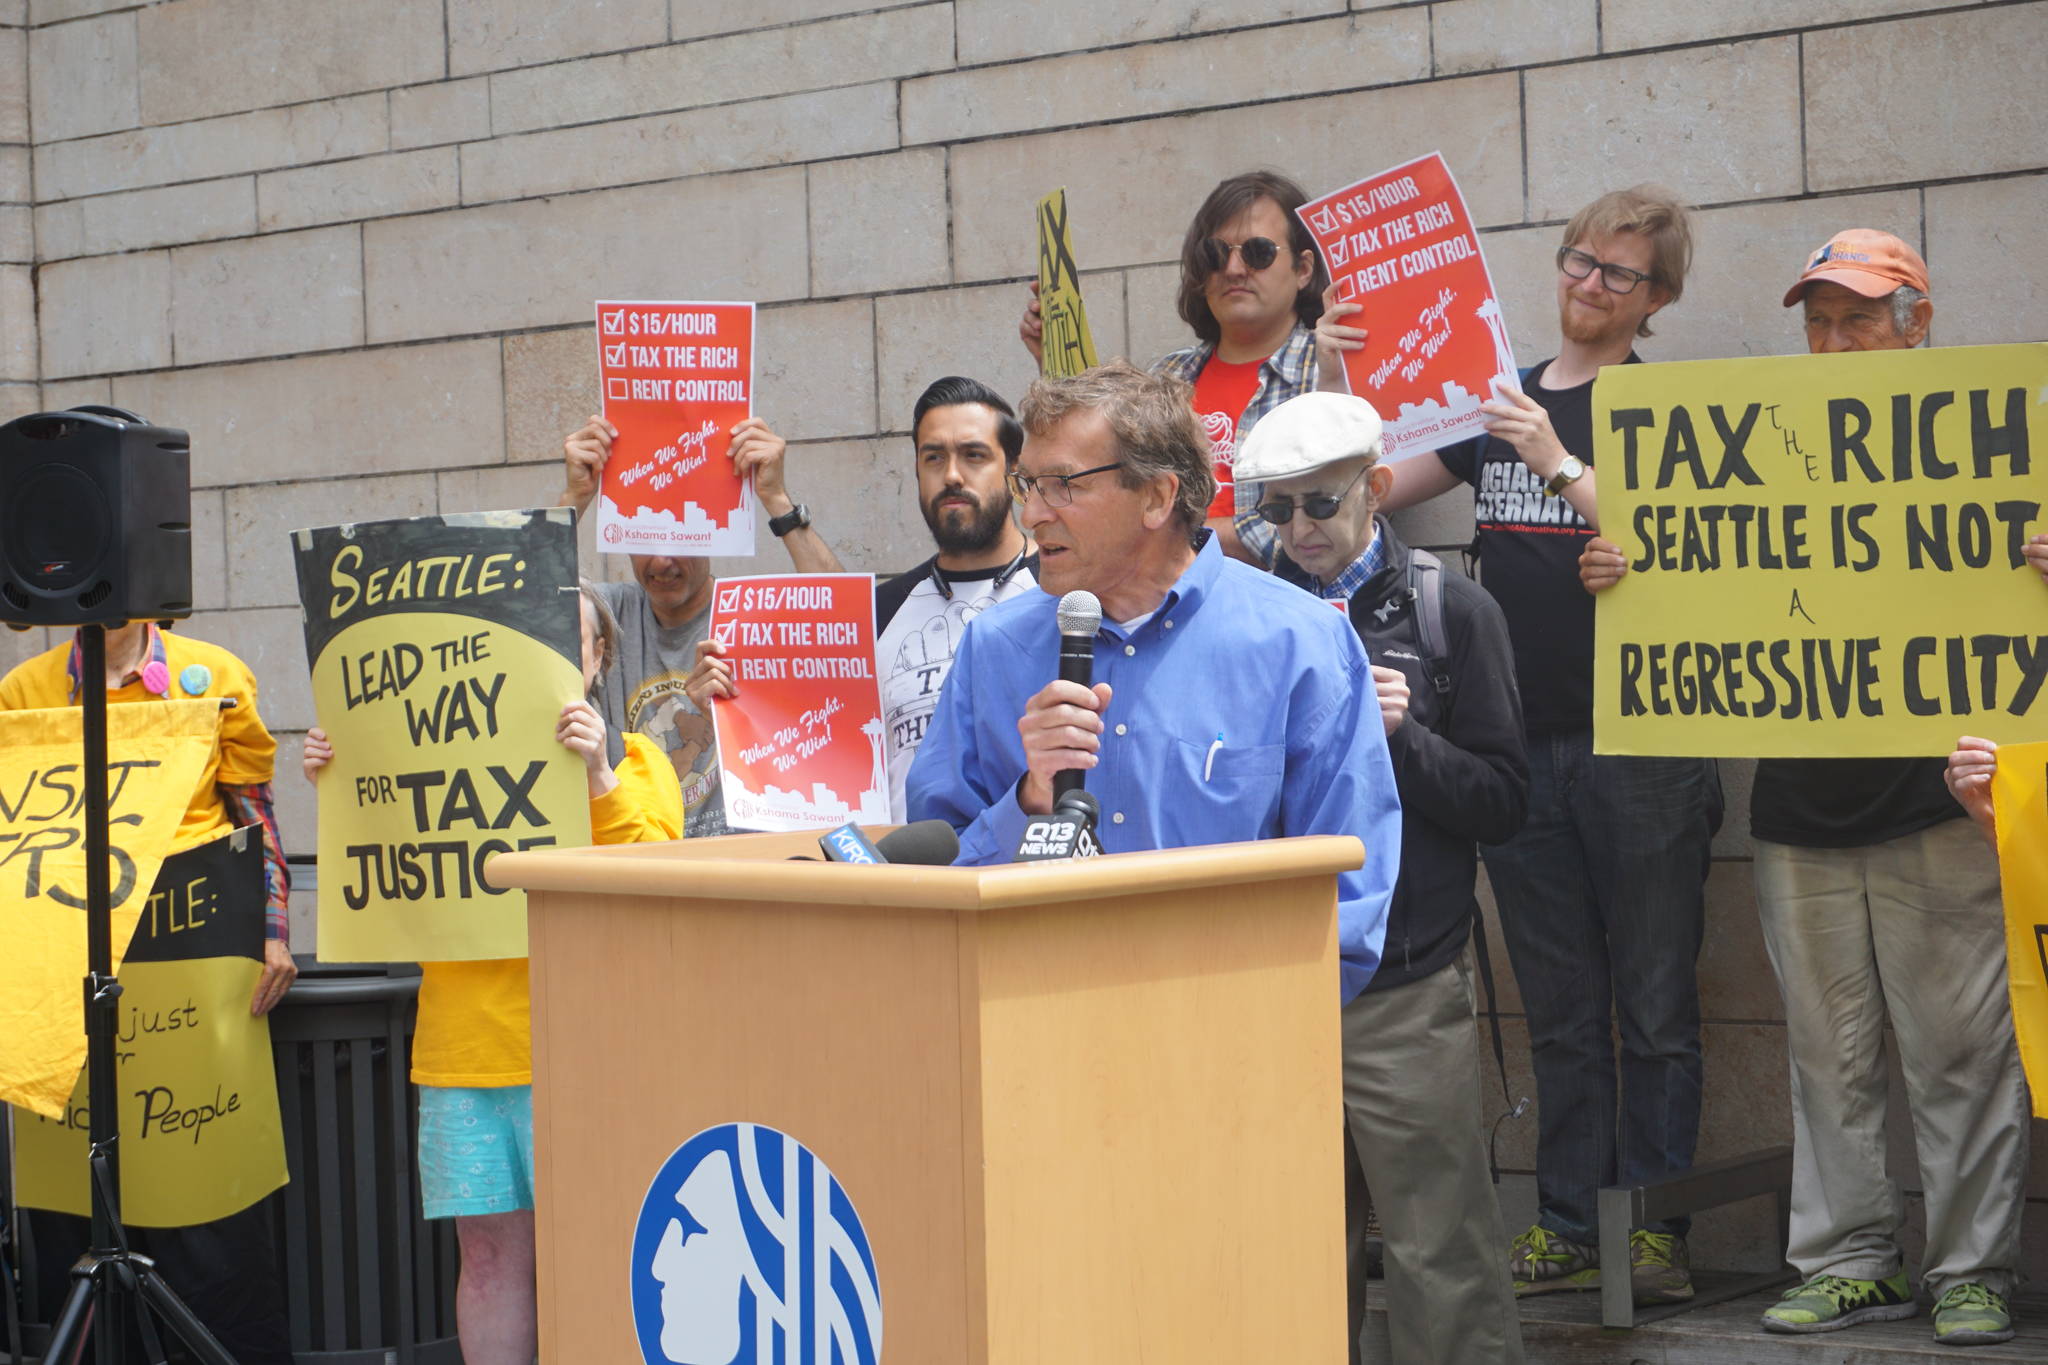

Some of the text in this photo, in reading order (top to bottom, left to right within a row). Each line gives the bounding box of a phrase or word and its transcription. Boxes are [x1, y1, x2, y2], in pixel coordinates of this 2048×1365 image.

[1336, 176, 1420, 224] $15/HOUR
[1349, 201, 1454, 258] TAX THE RICH
[1357, 235, 1476, 293] RENT CONTROL
[629, 312, 716, 335] $15/HOUR
[629, 346, 738, 368] TAX THE RICH
[1368, 352, 1402, 390] When
[1399, 329, 1422, 351] We
[1402, 317, 1453, 383] We Win!
[632, 379, 746, 402] RENT CONTROL
[1396, 423, 1440, 443] Kshama
[1610, 403, 1766, 490] TAX
[1828, 387, 2032, 483] RICH
[619, 459, 654, 487] When
[655, 445, 677, 463] We
[649, 447, 707, 491] We Win!
[1481, 462, 1549, 492] OCIAL
[625, 529, 711, 542] Kshama Sawant
[1632, 501, 2041, 573] SEATTLE IS NOT
[742, 586, 833, 611] $15/HOUR
[1789, 589, 1815, 624] A
[740, 622, 858, 646] TAX THE RICH
[341, 631, 491, 712] LEAD THE
[741, 658, 873, 680] RENT CONTROL
[1619, 633, 2048, 721] REGRESSIVE CITY
[404, 672, 507, 747] WAY
[738, 739, 775, 766] When
[774, 725, 799, 745] We
[772, 724, 833, 773] We Win!
[356, 760, 551, 833] FOR TAX
[1020, 843, 1068, 855] NEWS
[1026, 822, 1076, 843] Q13
[343, 836, 557, 911] JUSTIC
[119, 998, 198, 1042] just
[135, 1084, 241, 1144] People
